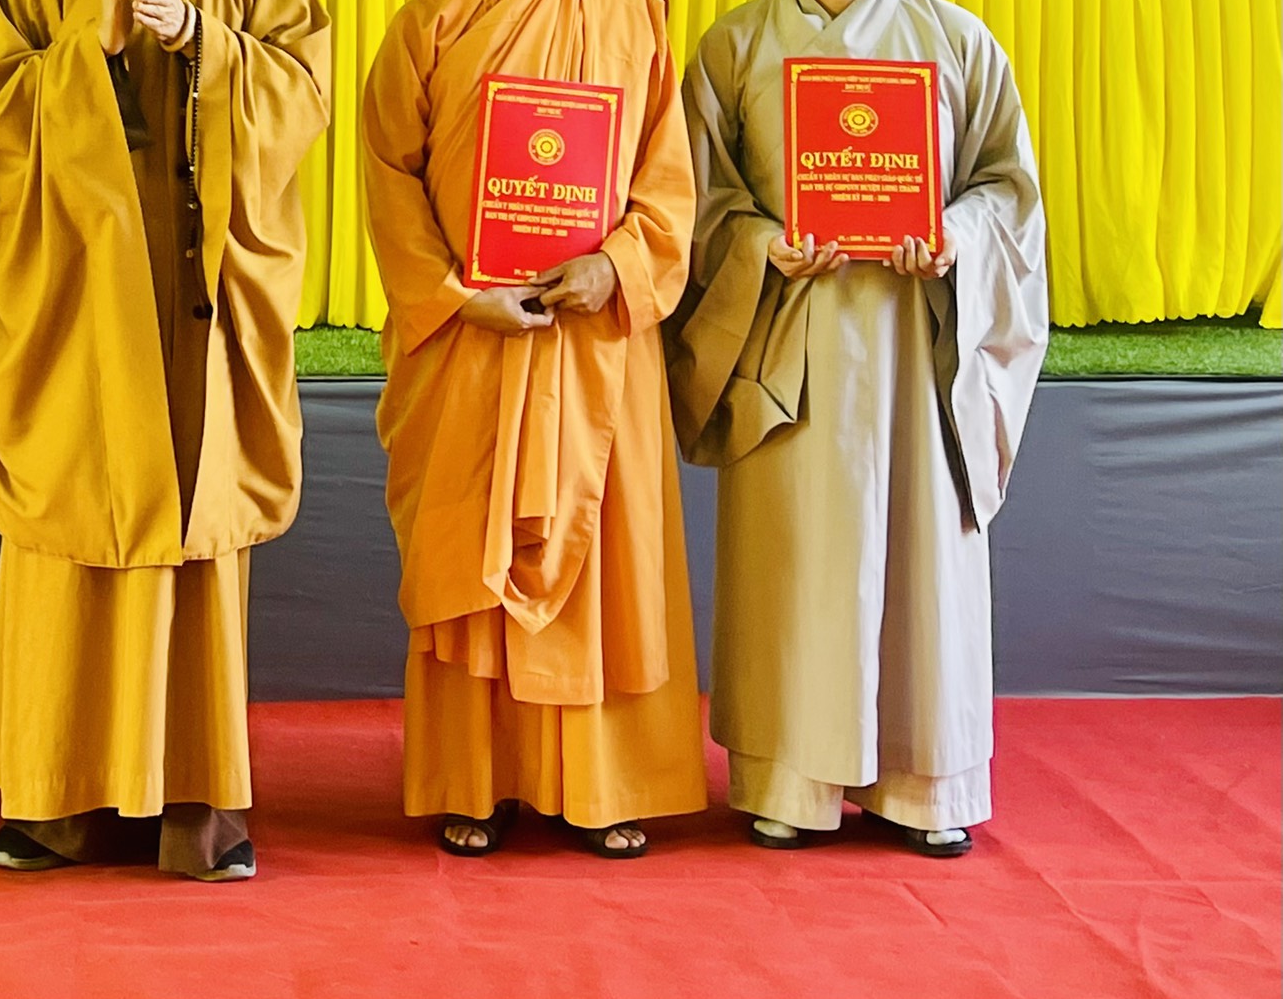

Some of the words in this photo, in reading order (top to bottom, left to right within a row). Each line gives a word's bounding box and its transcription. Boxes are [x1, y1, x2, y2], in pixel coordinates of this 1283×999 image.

[800, 146, 865, 169] QUYẾT
[870, 153, 920, 172] ĐỊNH
[486, 175, 549, 199] QUYẾT
[552, 183, 597, 204] ĐỊNH
